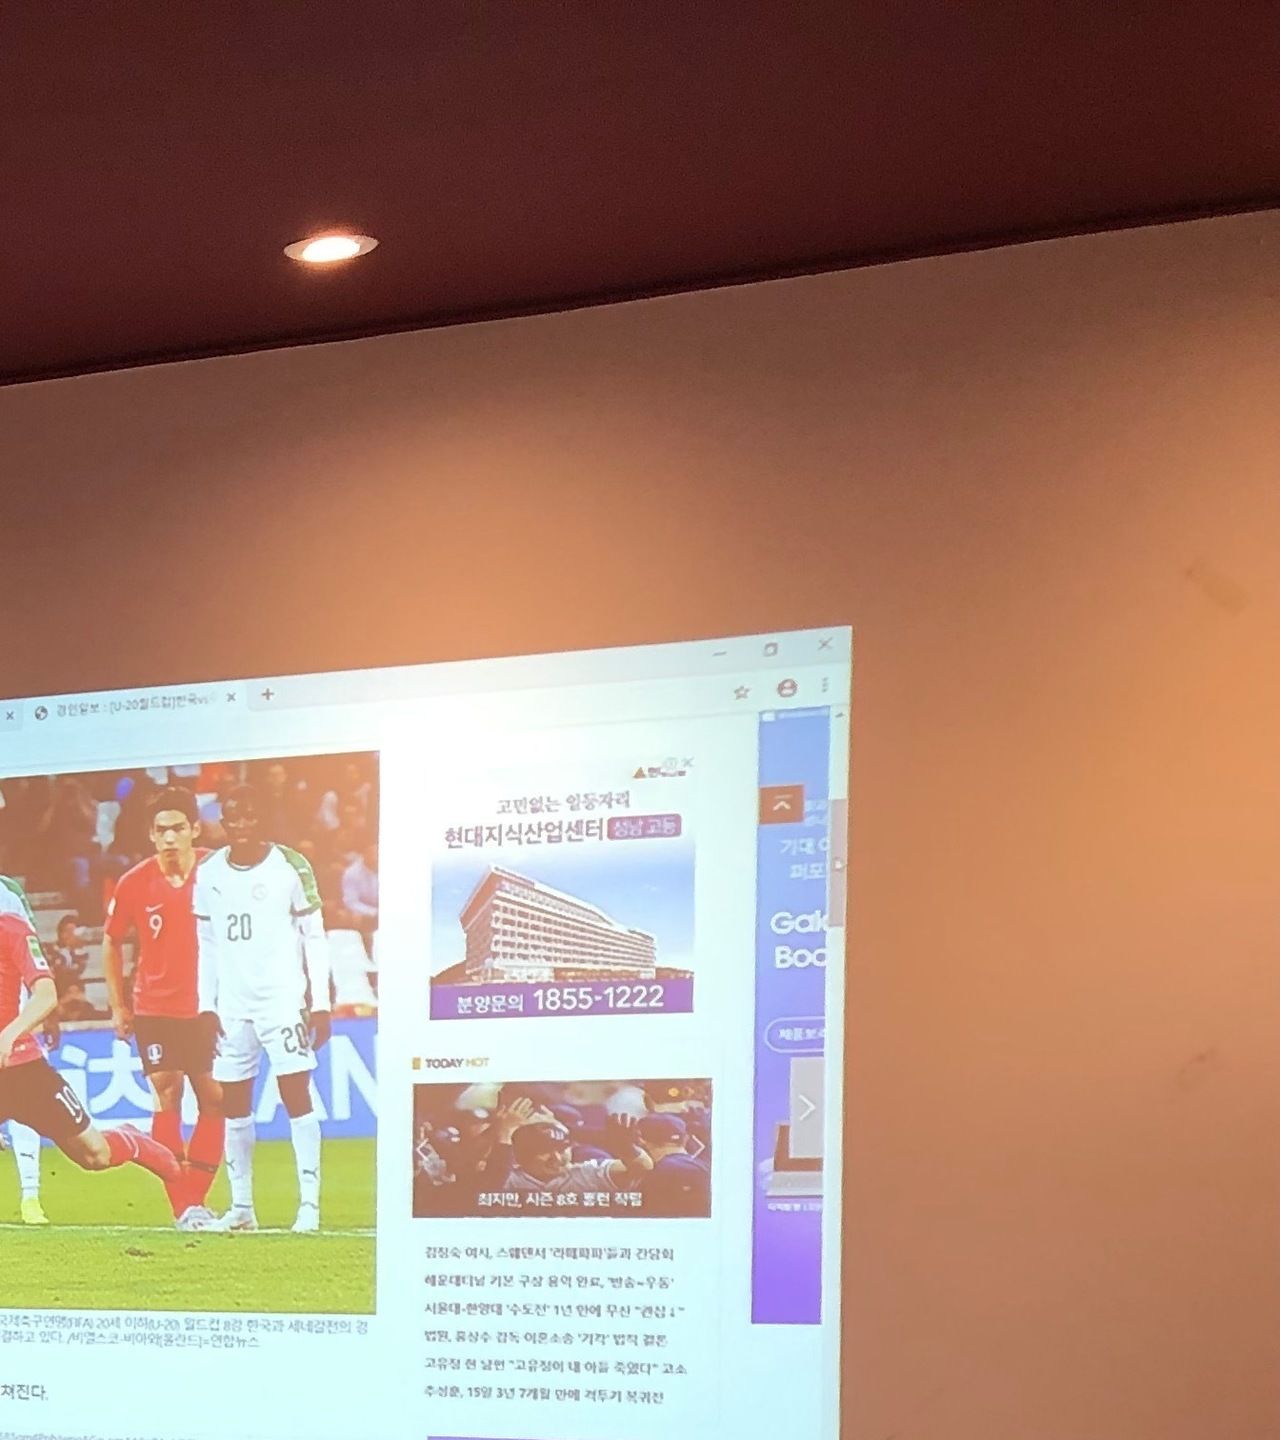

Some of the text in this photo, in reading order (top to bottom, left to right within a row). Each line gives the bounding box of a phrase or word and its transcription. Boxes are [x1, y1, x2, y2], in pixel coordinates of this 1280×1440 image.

[495, 796, 562, 815] 고민없는
[444, 817, 604, 849] 현대지식산업센터
[148, 913, 163, 939] 9
[226, 913, 253, 942] 20
[457, 984, 665, 1014] 분양문의 1855-1222
[424, 1057, 491, 1069] TODAY HOT
[478, 1191, 522, 1208] 최지만,
[526, 1191, 553, 1207] 시즌
[555, 1191, 578, 1206] 8호
[636, 1247, 675, 1261] 간담회
[183, 1317, 220, 1332] 월드컵
[246, 1318, 285, 1333] 한국과
[424, 1357, 461, 1371] 고유정
[584, 1360, 609, 1374] 아들
[662, 1362, 688, 1375] 고소
[467, 1385, 493, 1399] 15일
[496, 1386, 516, 1400] 3년
[518, 1386, 551, 1401] 7개월
[584, 1389, 623, 1403] 격투기
